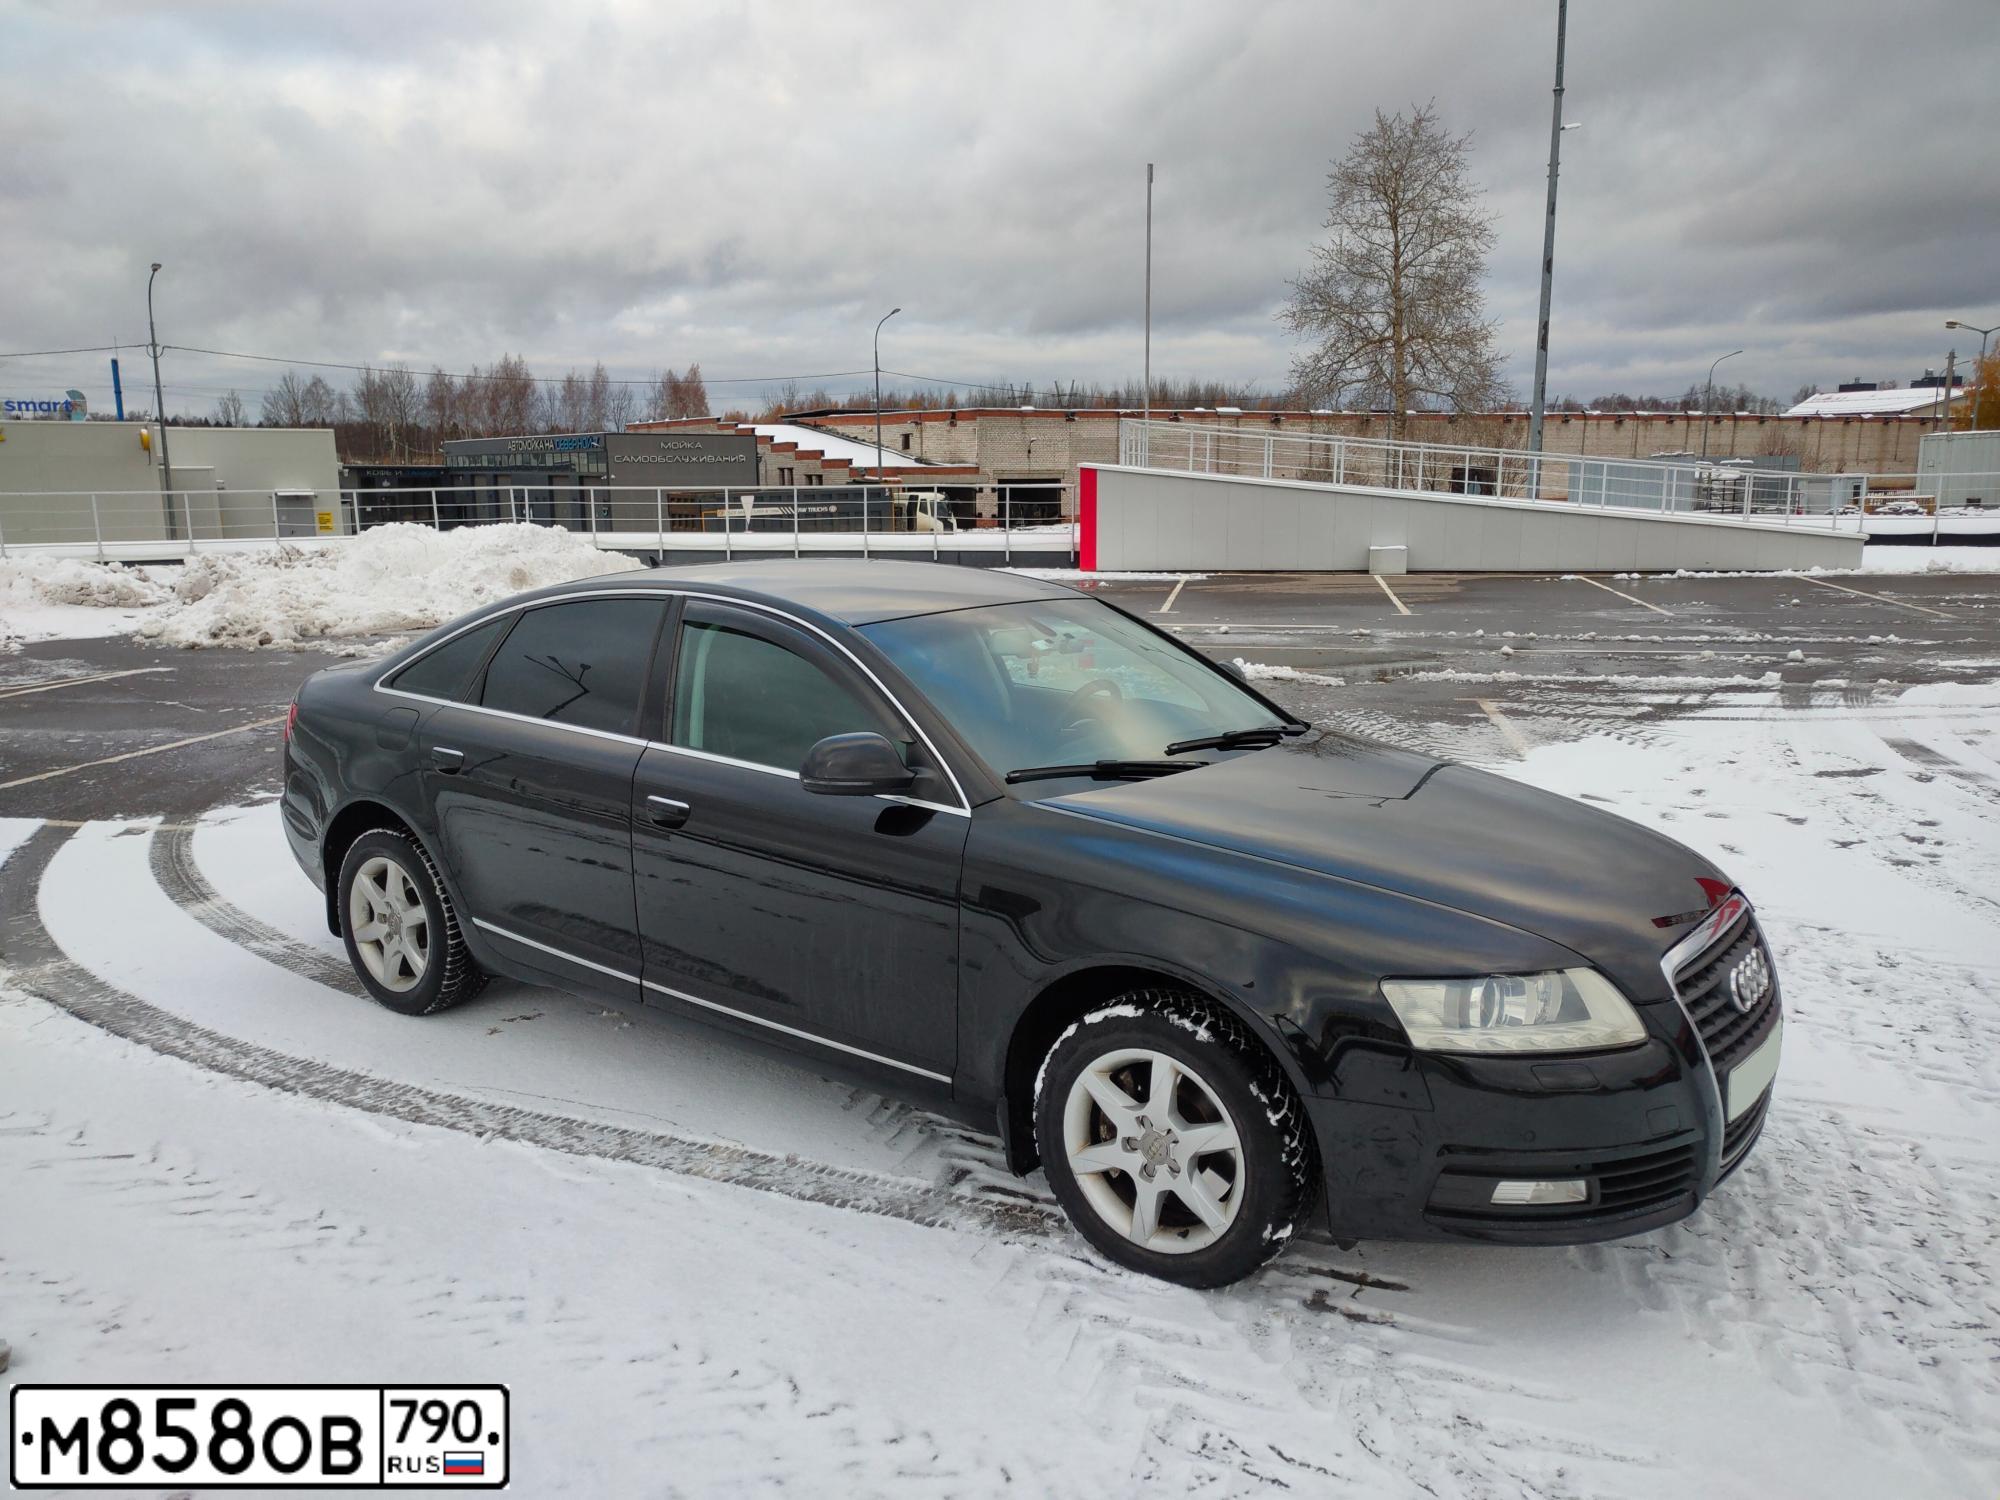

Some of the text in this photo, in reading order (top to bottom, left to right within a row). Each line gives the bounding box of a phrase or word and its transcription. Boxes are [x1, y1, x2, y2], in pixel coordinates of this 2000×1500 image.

[4, 399, 73, 412] smart
[507, 438, 545, 451] АВТОМОЙКА
[545, 438, 555, 450] НА
[660, 441, 703, 450] МОЙКА
[614, 454, 747, 464] САМООБСЛУЖИВАНИЯ
